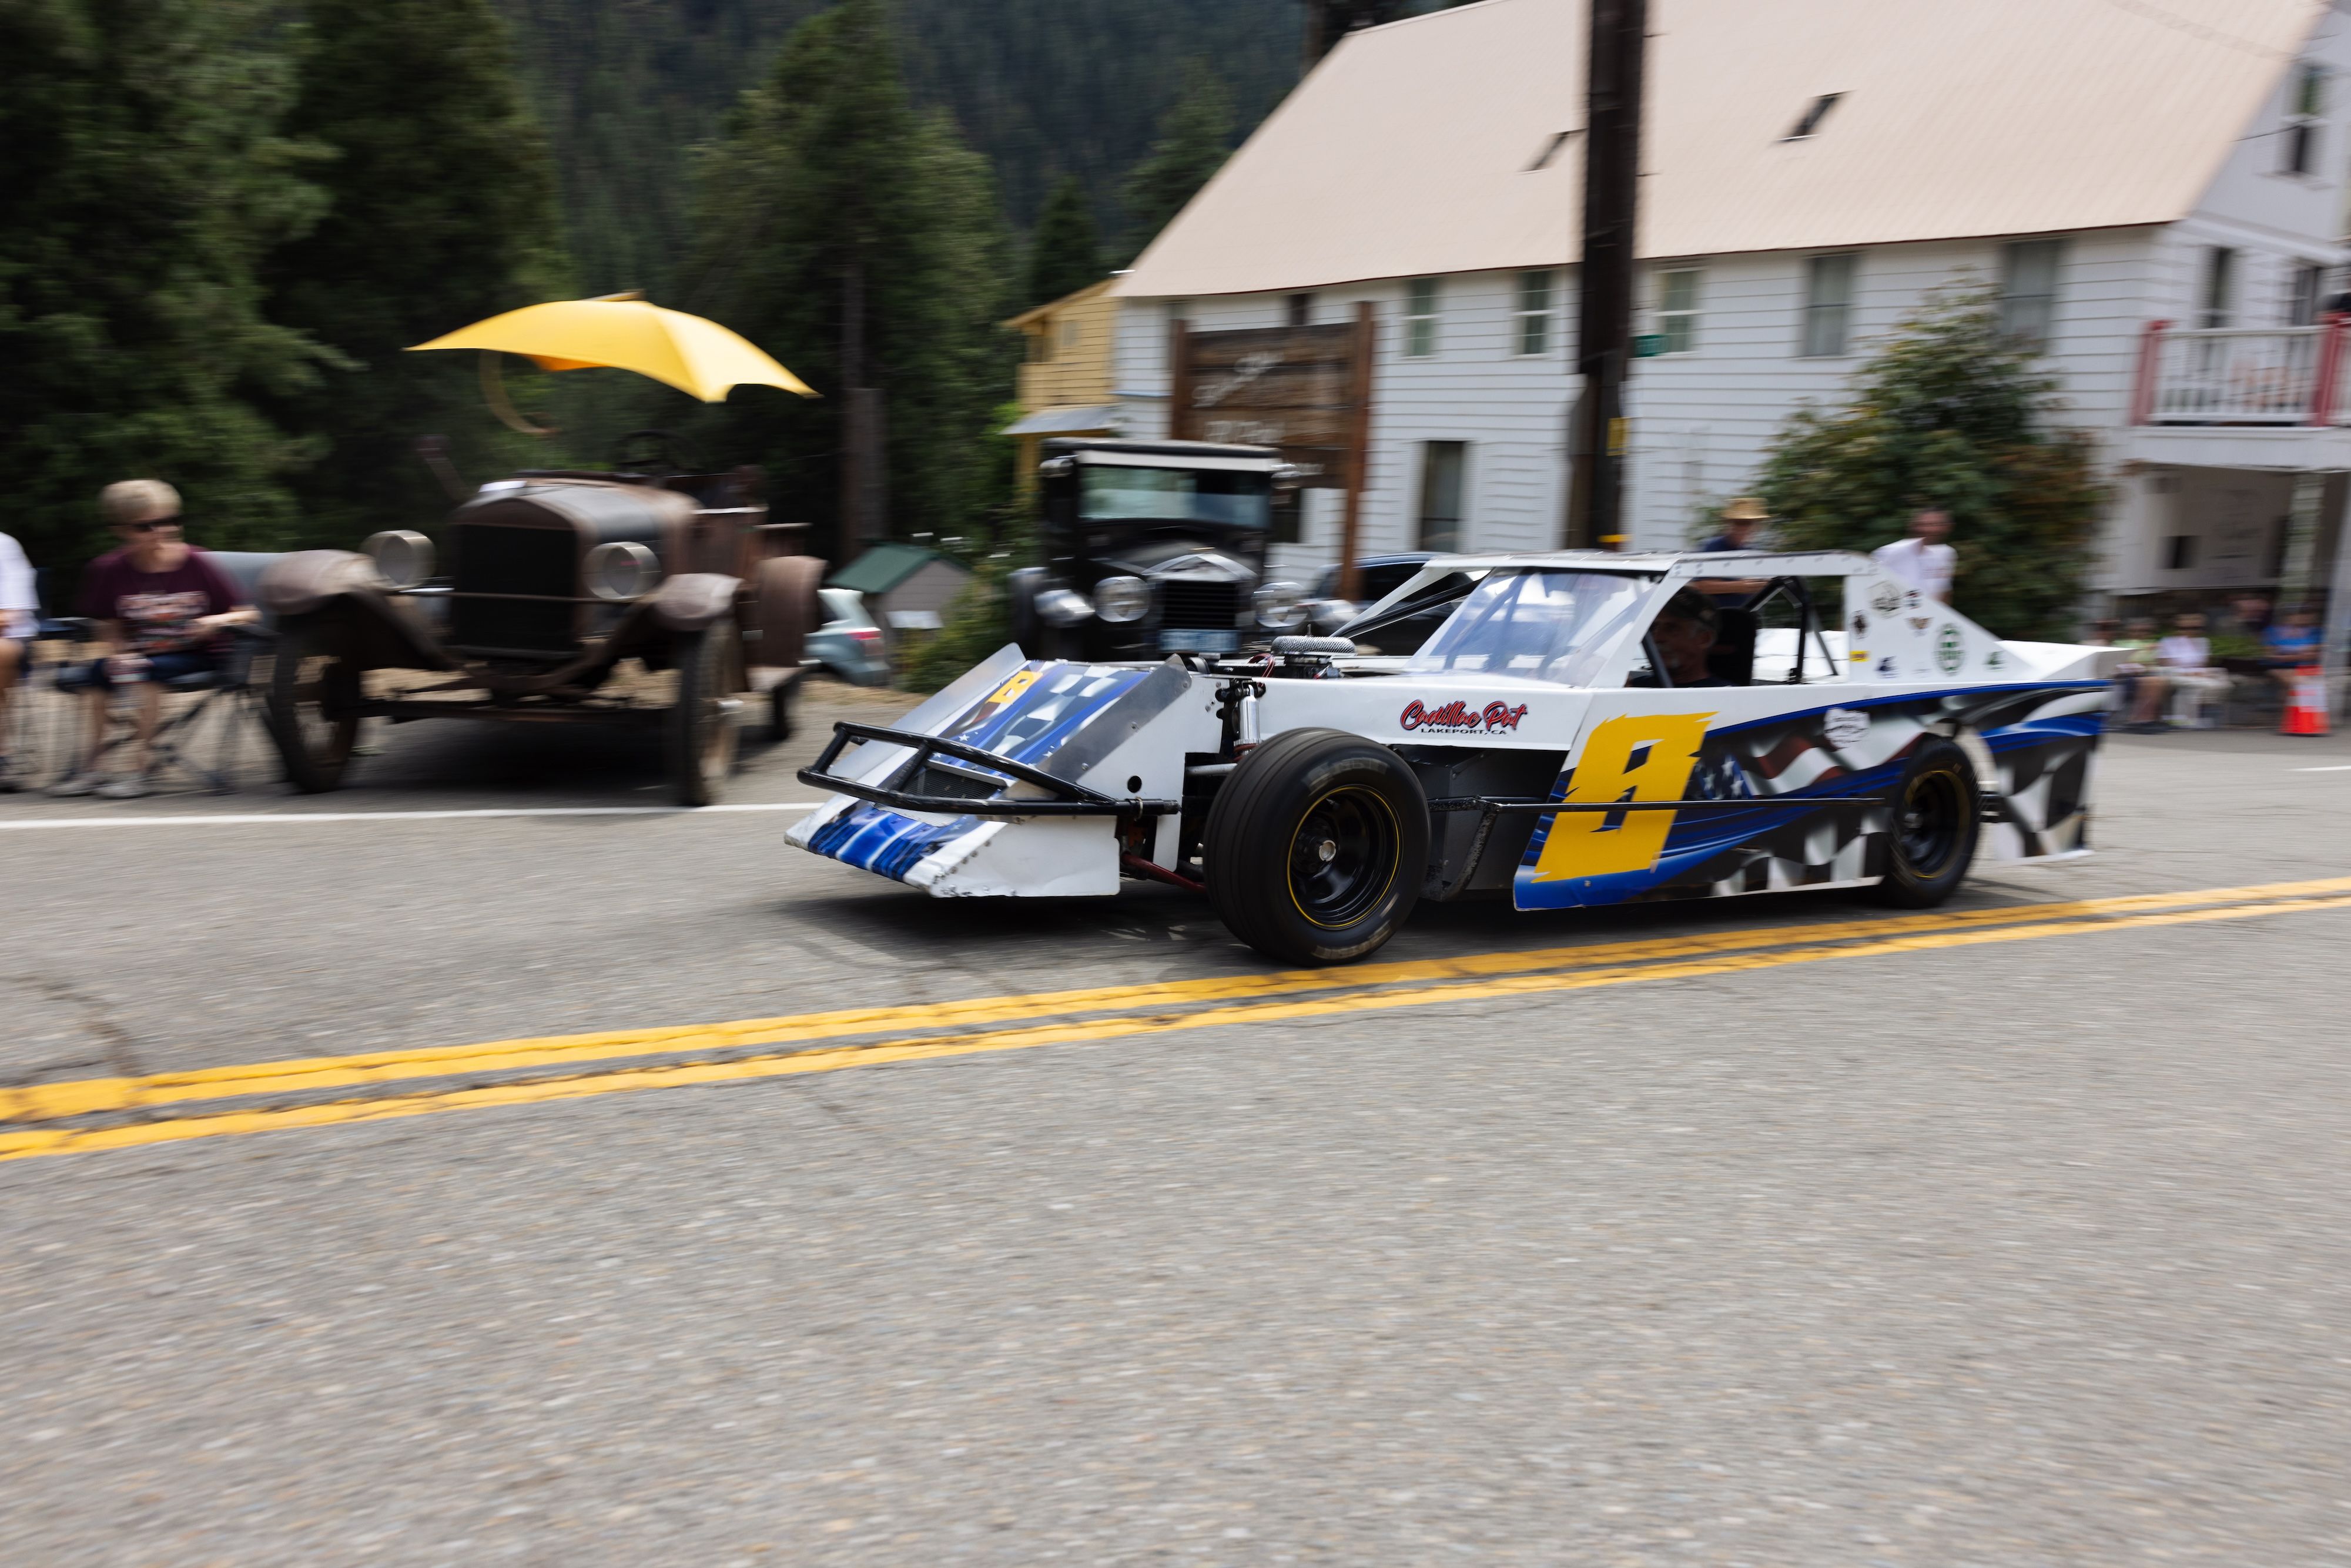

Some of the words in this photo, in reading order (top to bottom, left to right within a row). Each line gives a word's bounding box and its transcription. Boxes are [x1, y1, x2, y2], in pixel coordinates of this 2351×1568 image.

[985, 670, 1044, 705] 8
[1400, 699, 1482, 731] Cadillac
[1483, 701, 1528, 731] Pat
[1531, 711, 1721, 883] 8
